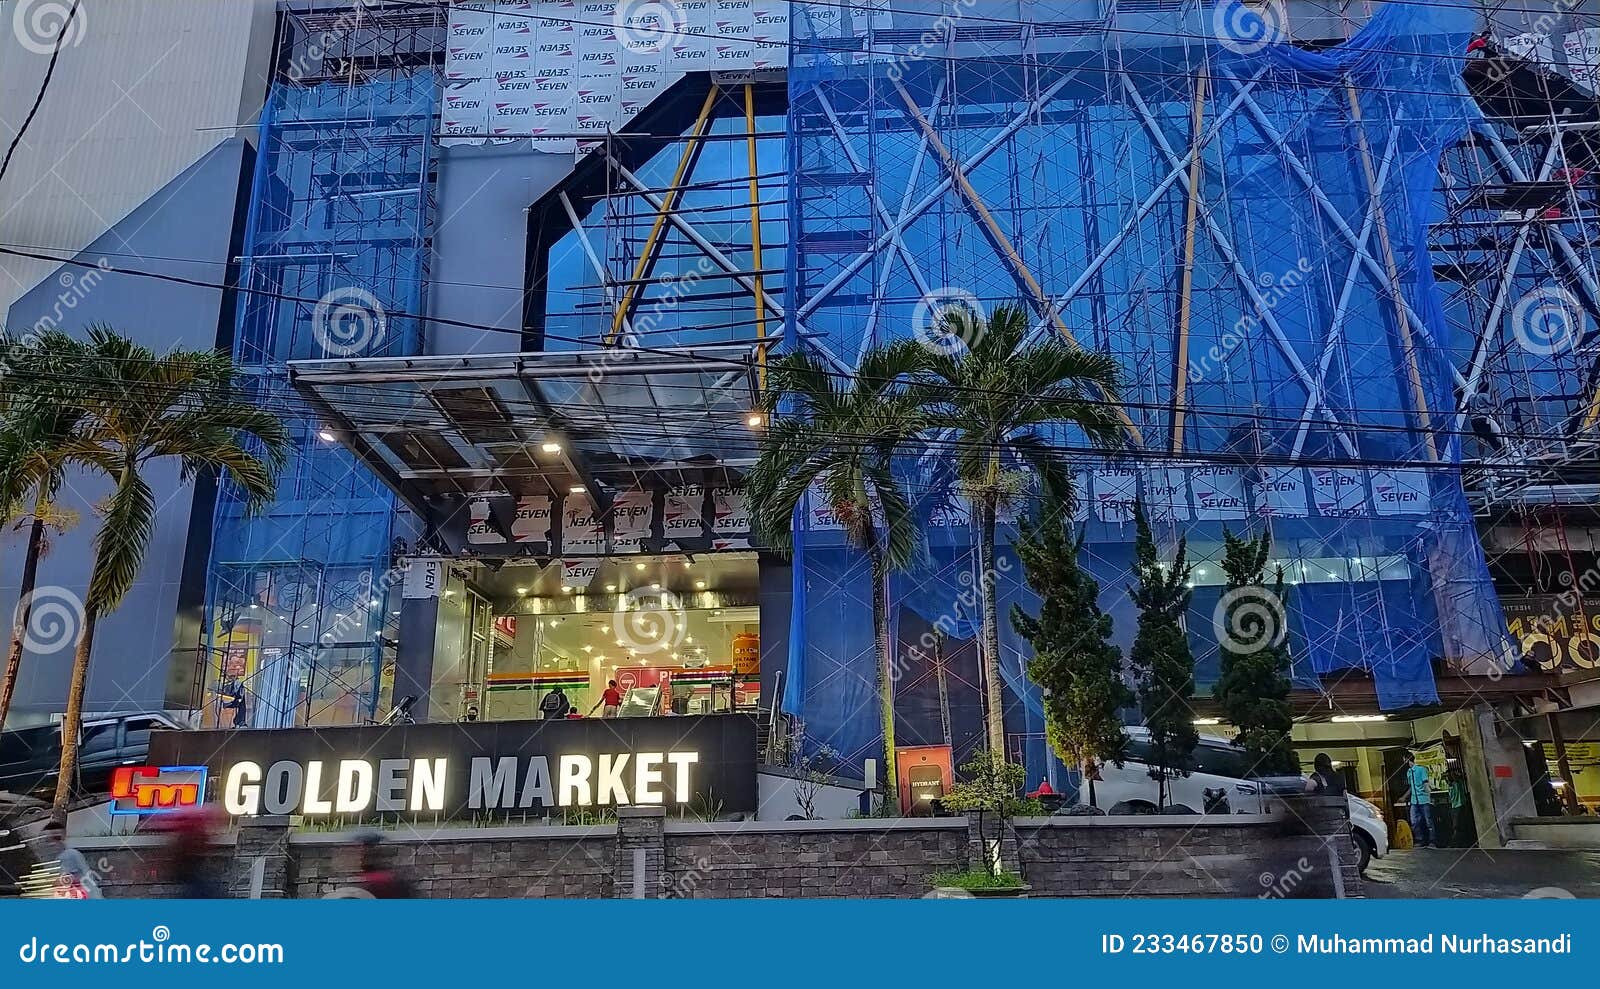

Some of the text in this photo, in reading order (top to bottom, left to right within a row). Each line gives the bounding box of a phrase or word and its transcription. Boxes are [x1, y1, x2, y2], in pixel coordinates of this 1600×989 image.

[584, 4, 615, 12] SEVEN
[675, 2, 706, 10] SEVEN
[718, 1, 749, 10] SEVEN
[541, 19, 571, 28] SEVEN
[627, 16, 658, 24] SEVEN
[756, 15, 787, 24] SEVEN
[498, 21, 528, 29] SEVEN
[453, 28, 485, 36] SEVEN
[583, 28, 614, 37] SEVEN
[674, 26, 706, 34] SEVEN
[718, 25, 749, 34] SEVEN
[539, 44, 571, 52] SEVEN
[627, 40, 658, 48] SEVEN
[496, 46, 528, 54] SEVEN
[452, 52, 483, 60] SEVEN
[582, 53, 614, 61] SEVEN
[674, 50, 706, 59] SEVEN
[718, 50, 749, 59] SEVEN
[538, 69, 569, 77] SEVEN
[625, 65, 657, 73] SEVEN
[495, 70, 526, 79] SEVEN
[499, 82, 530, 91] SEVEN
[537, 82, 568, 91] SEVEN
[623, 81, 656, 89] SEVEN
[580, 95, 612, 104] SEVEN
[448, 101, 480, 109] SEVEN
[497, 107, 529, 116] SEVEN
[535, 107, 567, 116] SEVEN
[579, 121, 611, 129] SEVEN
[447, 126, 478, 134] SEVEN
[578, 146, 599, 154] SEV
[1381, 493, 1418, 502] SEVEN
[1201, 499, 1238, 507] SEVEN
[515, 510, 549, 518] SEVEN
[224, 752, 699, 815] GOLDEN MARKET
